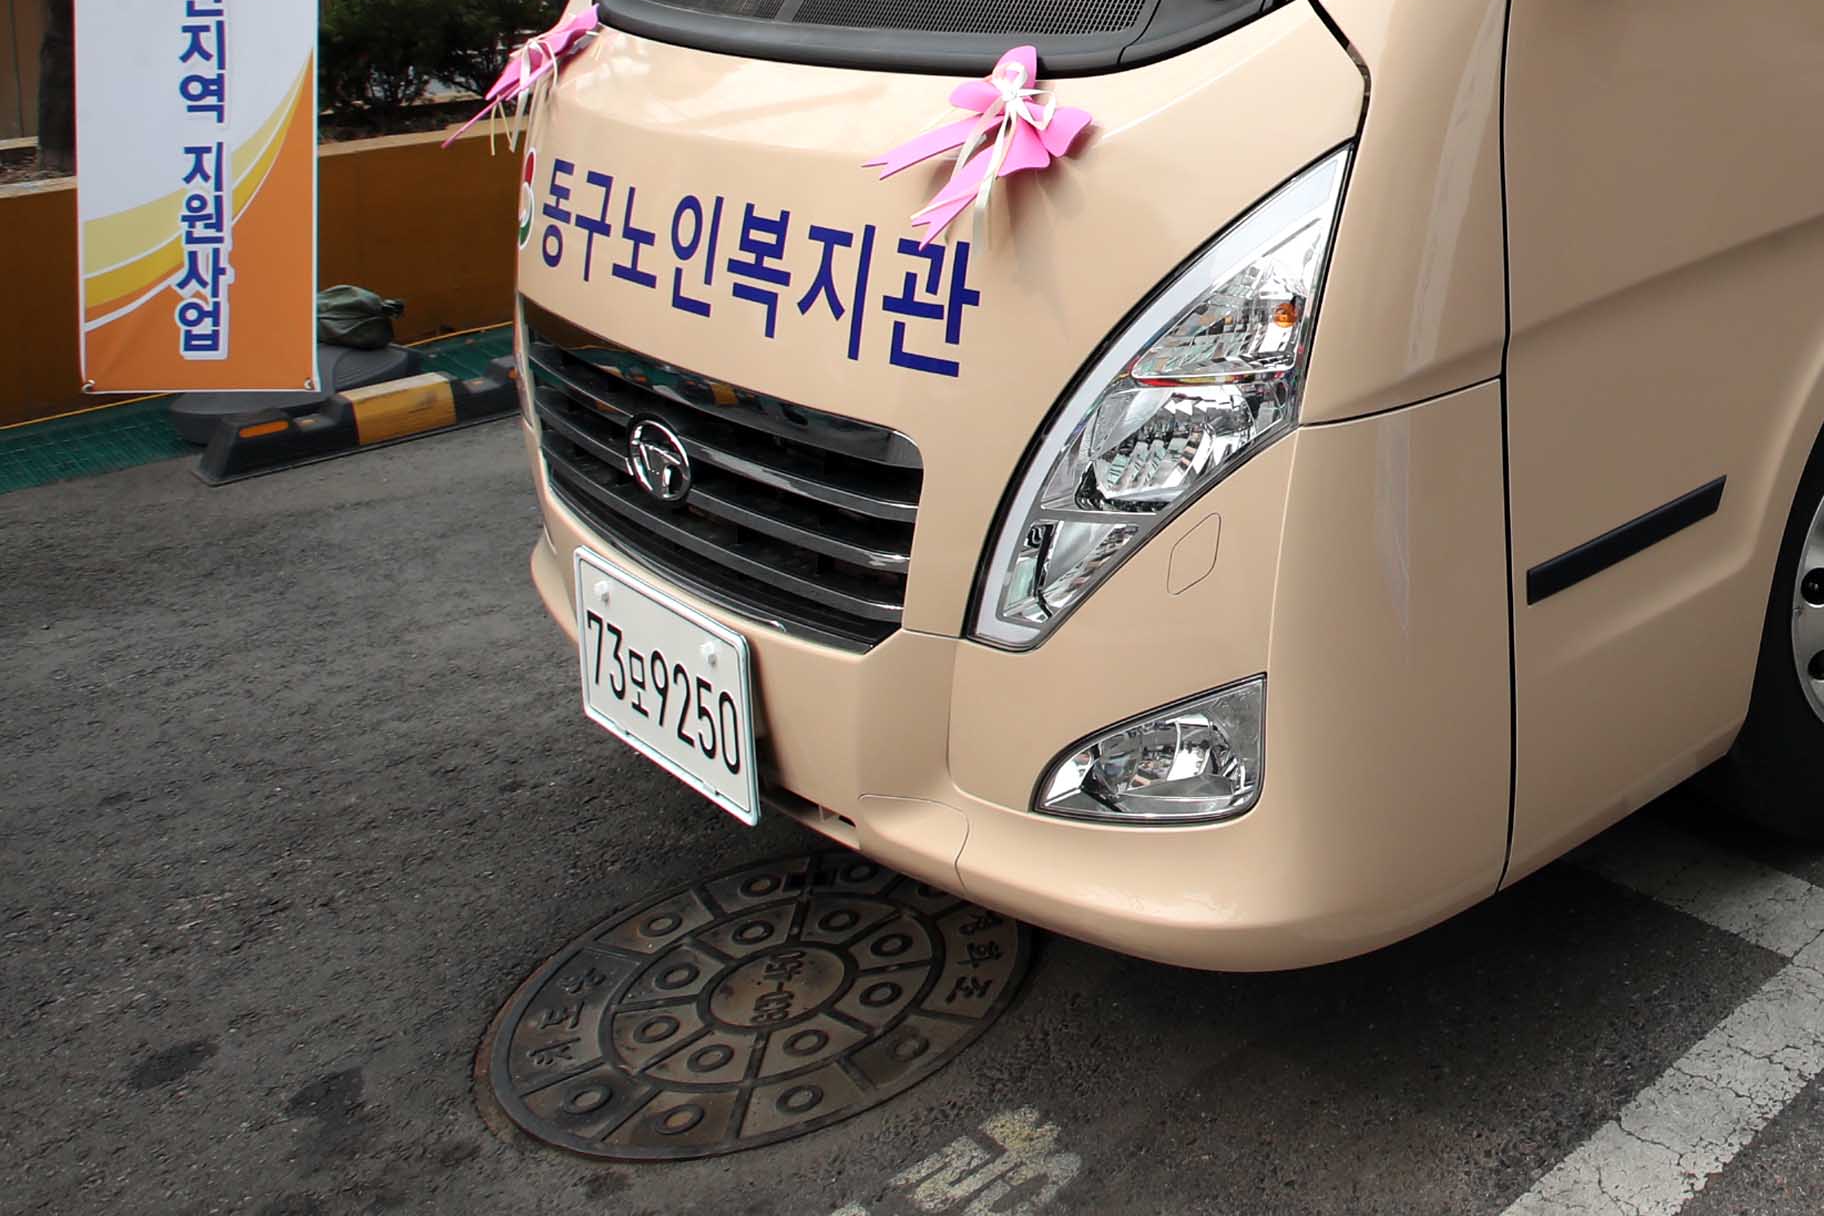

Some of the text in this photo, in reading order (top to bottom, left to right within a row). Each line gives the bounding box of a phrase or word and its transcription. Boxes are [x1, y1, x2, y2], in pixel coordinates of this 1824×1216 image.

[174, 141, 227, 354] 지원사업
[542, 158, 980, 377] 동구노인복지관
[586, 609, 741, 775] 73모9250
